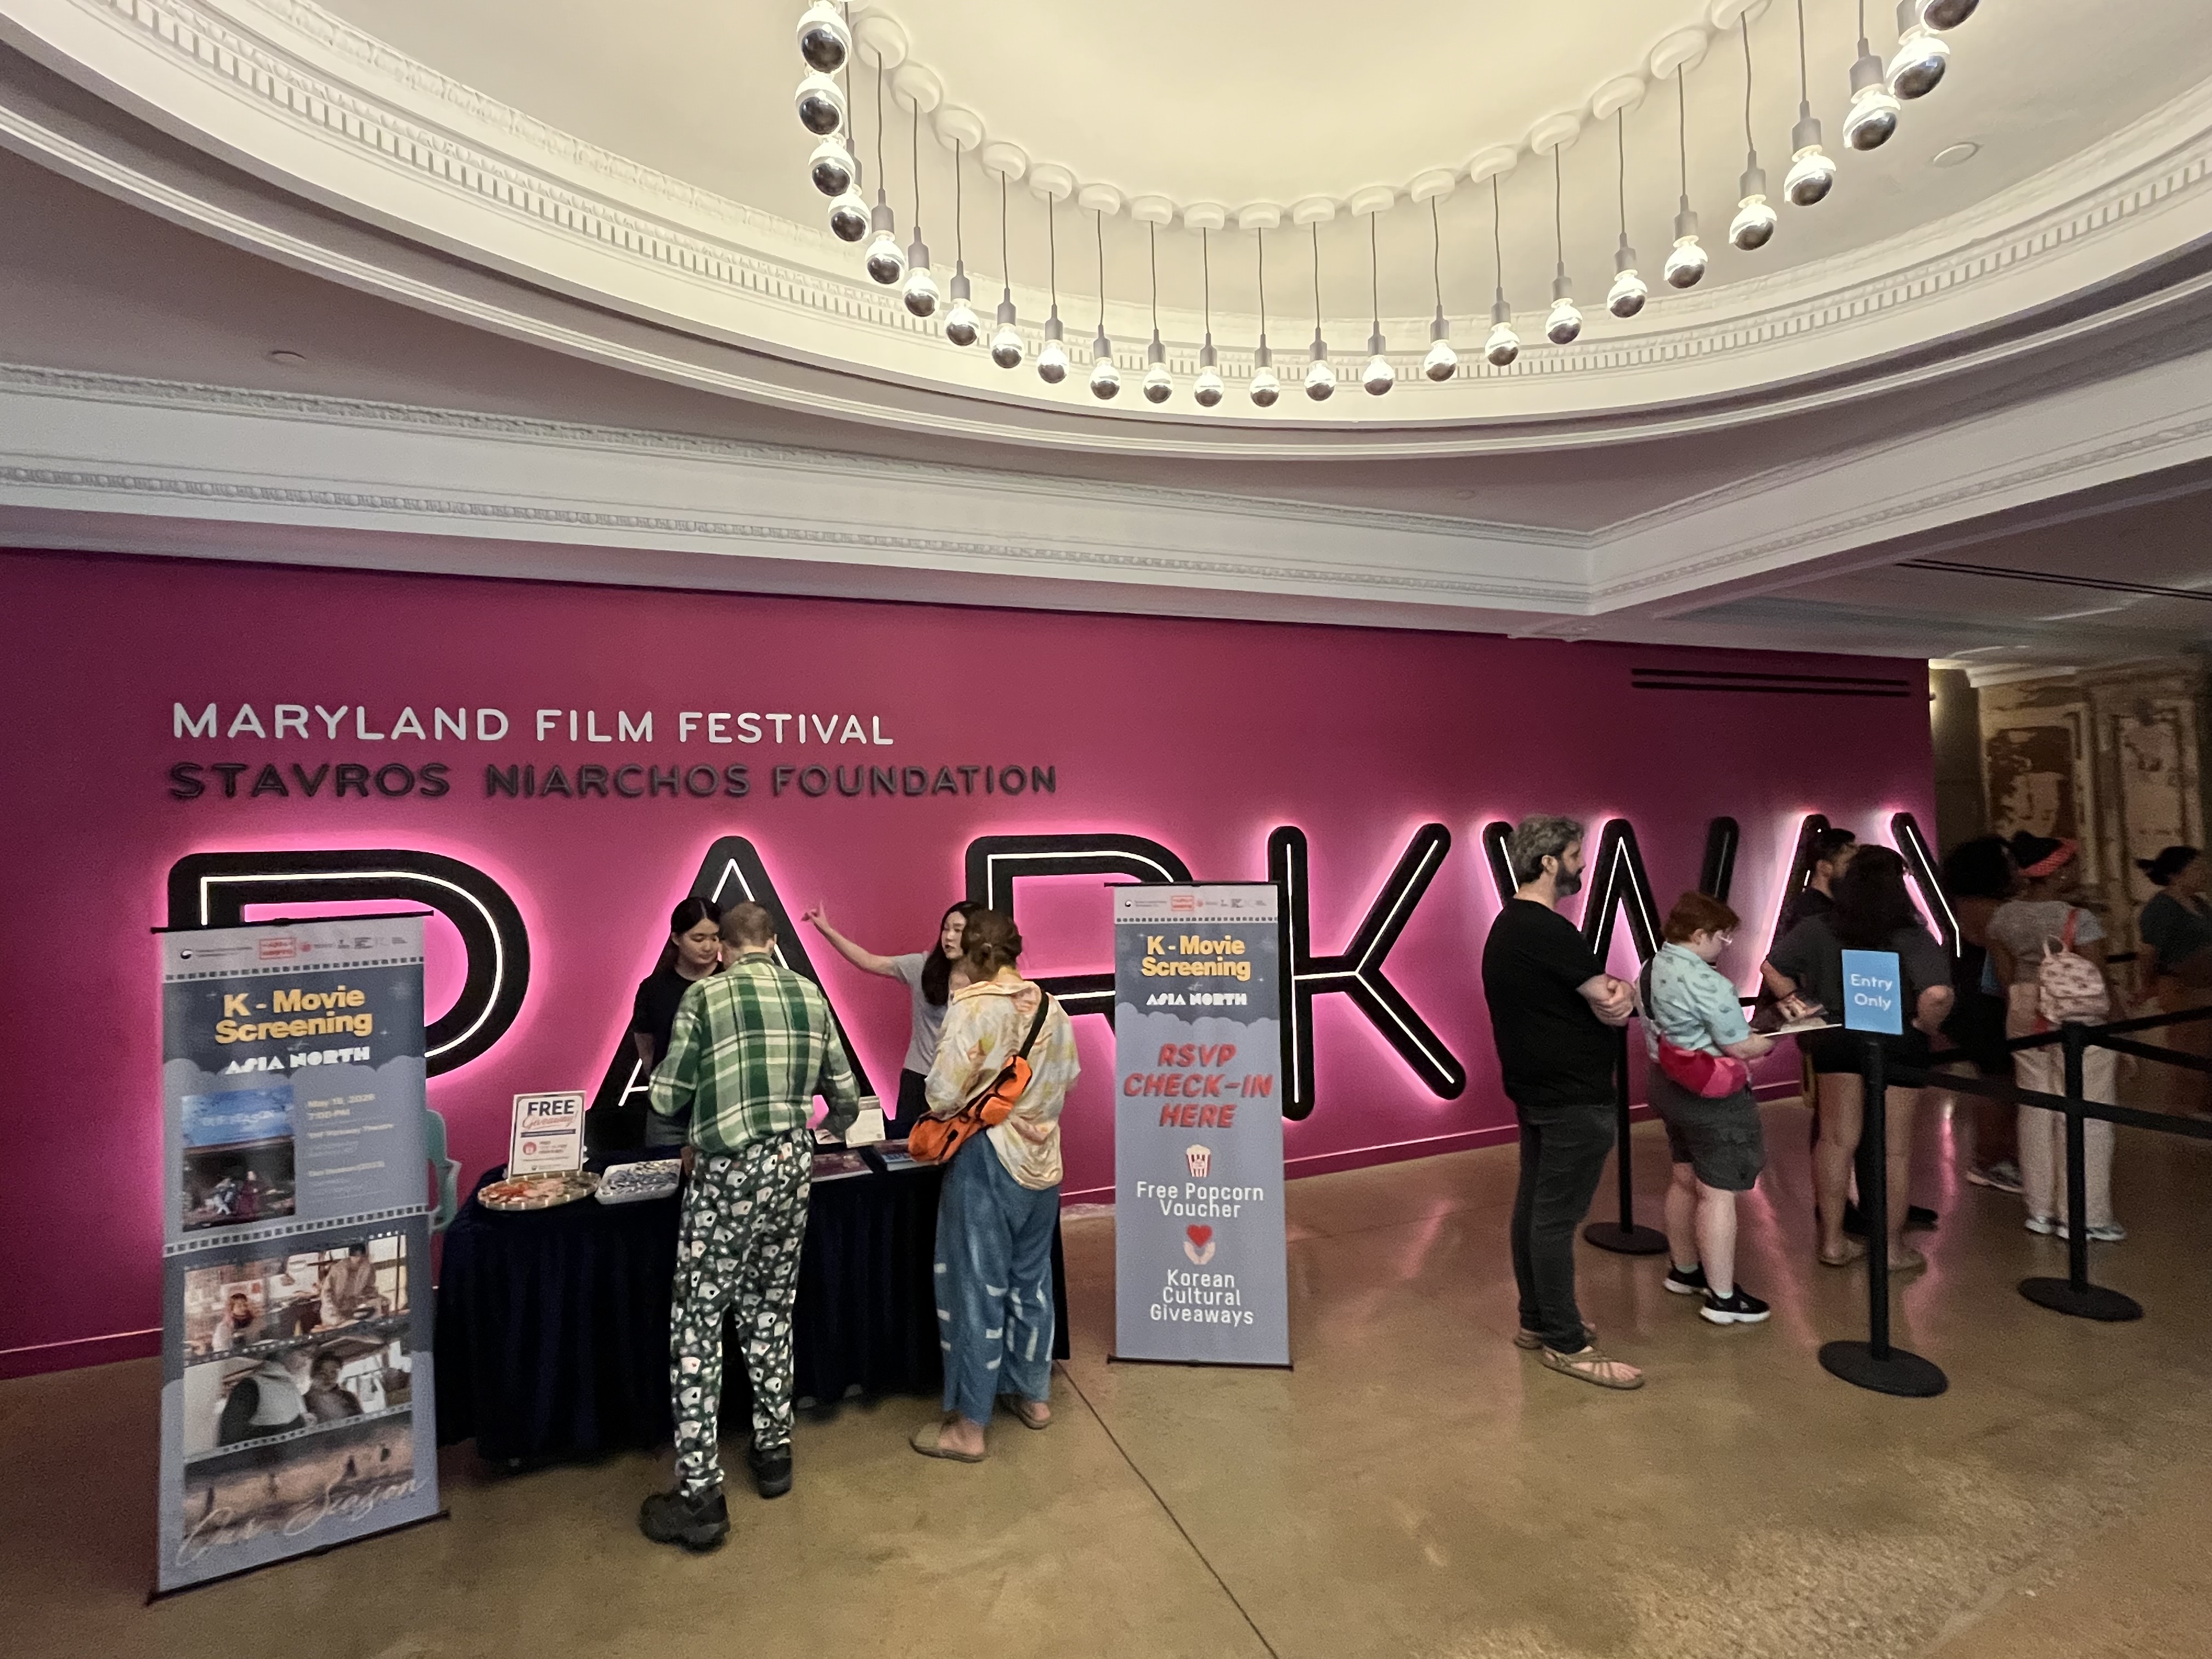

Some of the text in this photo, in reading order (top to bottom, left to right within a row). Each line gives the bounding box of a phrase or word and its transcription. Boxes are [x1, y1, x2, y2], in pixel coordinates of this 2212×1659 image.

[173, 702, 894, 745] MARYLAND FILM FESTIVAL
[170, 761, 1057, 798] STAVROS NIARCHOS FOUNDATION
[1147, 935, 1166, 955] K
[1180, 935, 1245, 955] Movie
[1142, 956, 1251, 981] Screening
[1850, 973, 1893, 992] Entry
[224, 992, 251, 1017] K
[273, 985, 365, 1013] Movie
[1146, 993, 1247, 1006] ASIA NORTH
[1854, 993, 1892, 1011] Only
[215, 1011, 373, 1044] Screening
[224, 1046, 370, 1075] ASIA NORTH
[1158, 1043, 1237, 1067] RSVP
[1124, 1073, 1273, 1098] CHECK-IN
[527, 1099, 575, 1116] FREE
[1159, 1103, 1237, 1128] HERE
[1137, 1181, 1263, 1207] Free Popcorn
[1160, 1199, 1241, 1218] Voucher
[1167, 1269, 1235, 1288] Korean
[1163, 1286, 1241, 1306] Cultural
[1150, 1304, 1254, 1327] Giveaways
